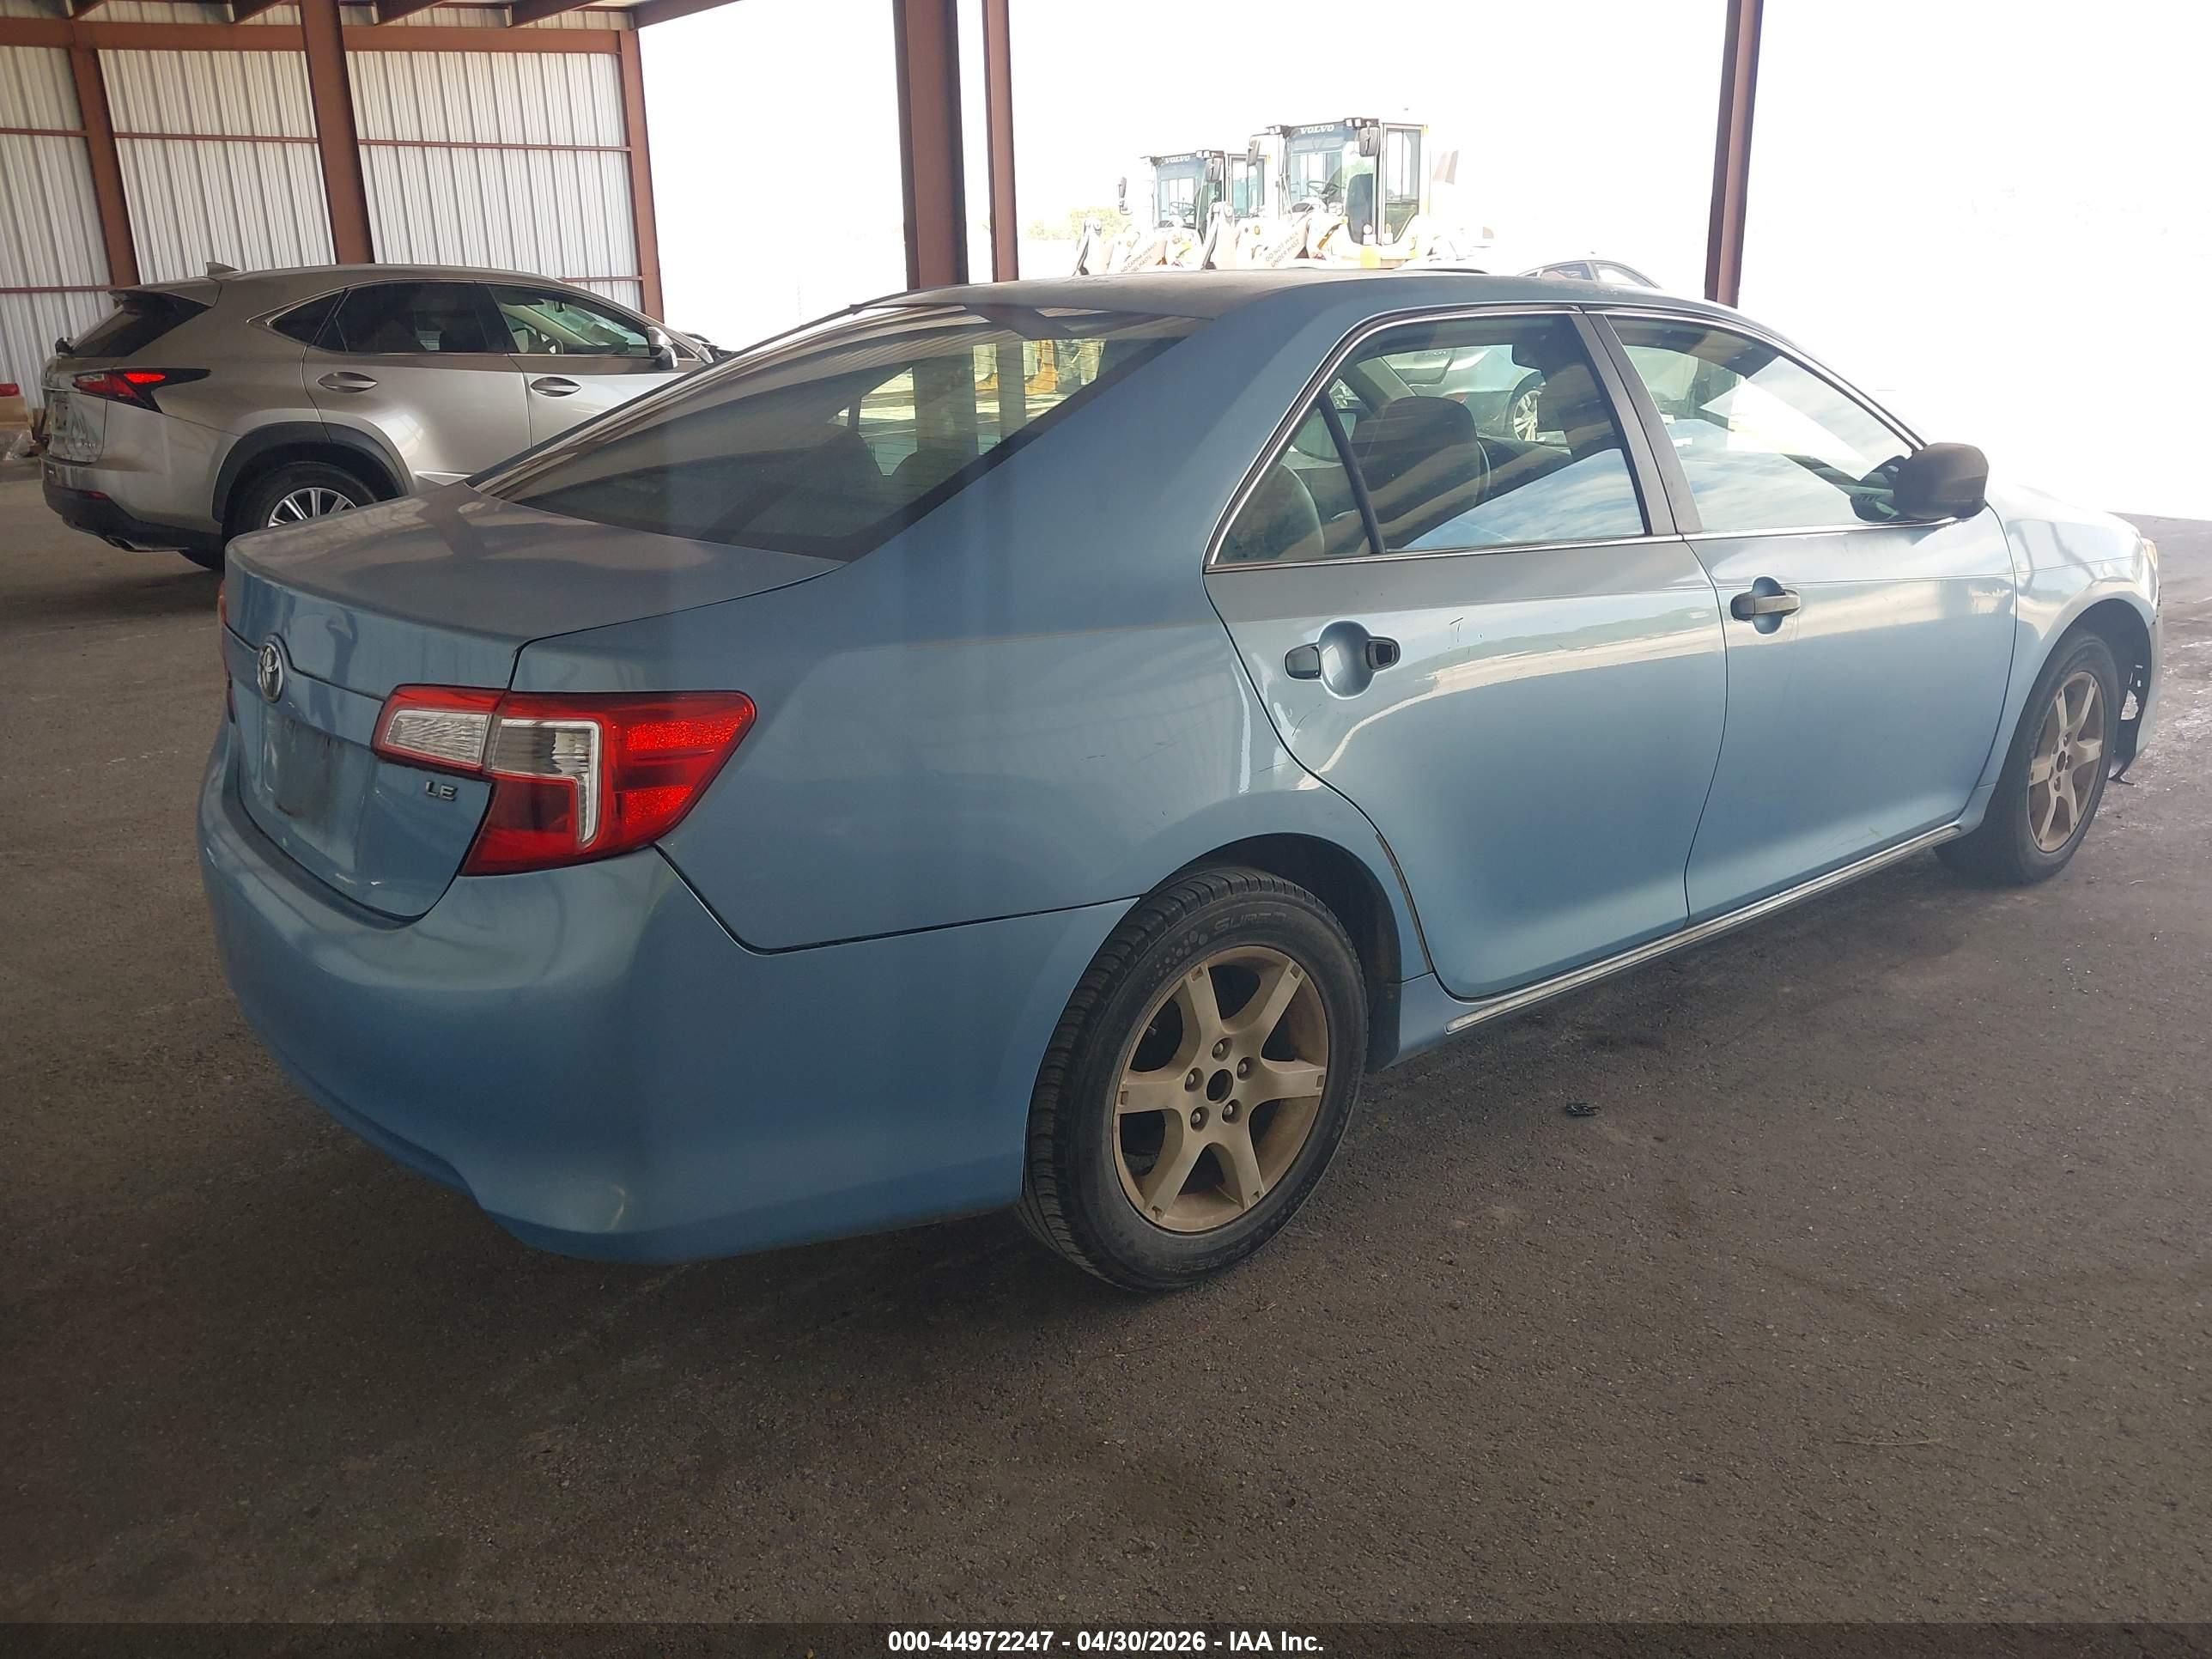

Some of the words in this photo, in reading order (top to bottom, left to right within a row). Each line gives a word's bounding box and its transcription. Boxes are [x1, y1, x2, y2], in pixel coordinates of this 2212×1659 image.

[1299, 124, 1334, 135] VOLVO
[1165, 155, 1190, 164] VOLVO
[426, 781, 457, 801] LE
